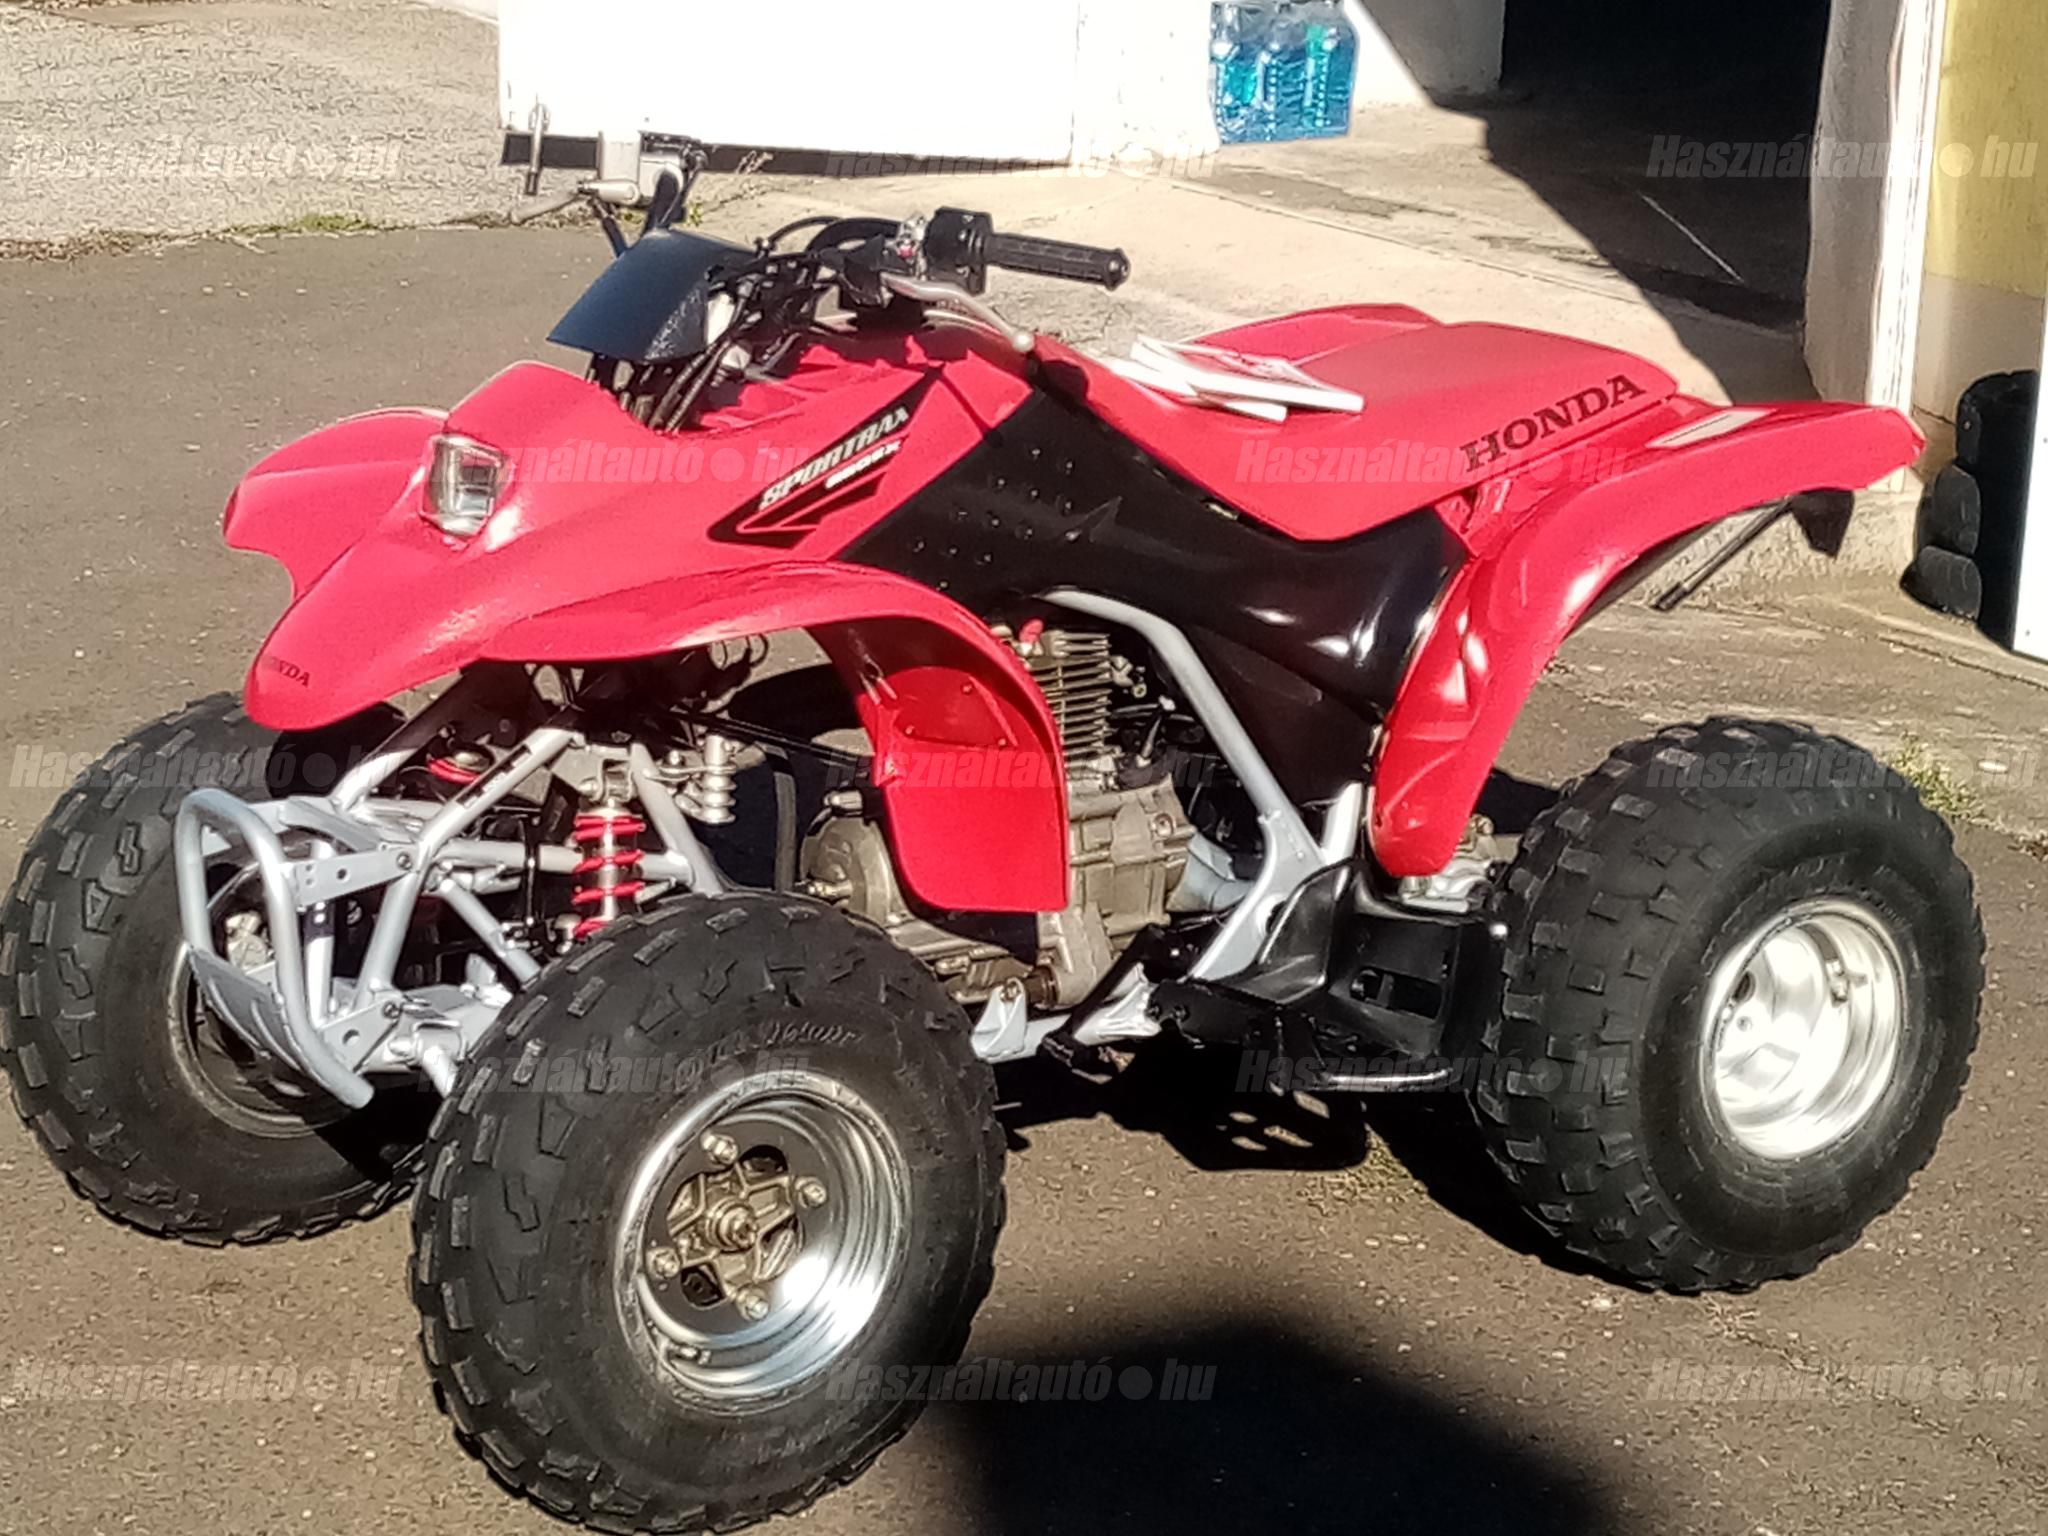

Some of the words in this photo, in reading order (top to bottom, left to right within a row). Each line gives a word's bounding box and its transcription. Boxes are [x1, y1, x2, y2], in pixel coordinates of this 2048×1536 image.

[758, 406, 910, 512] SPORTRAX
[1460, 374, 1647, 472] HONDA
[262, 655, 311, 688] NDA
